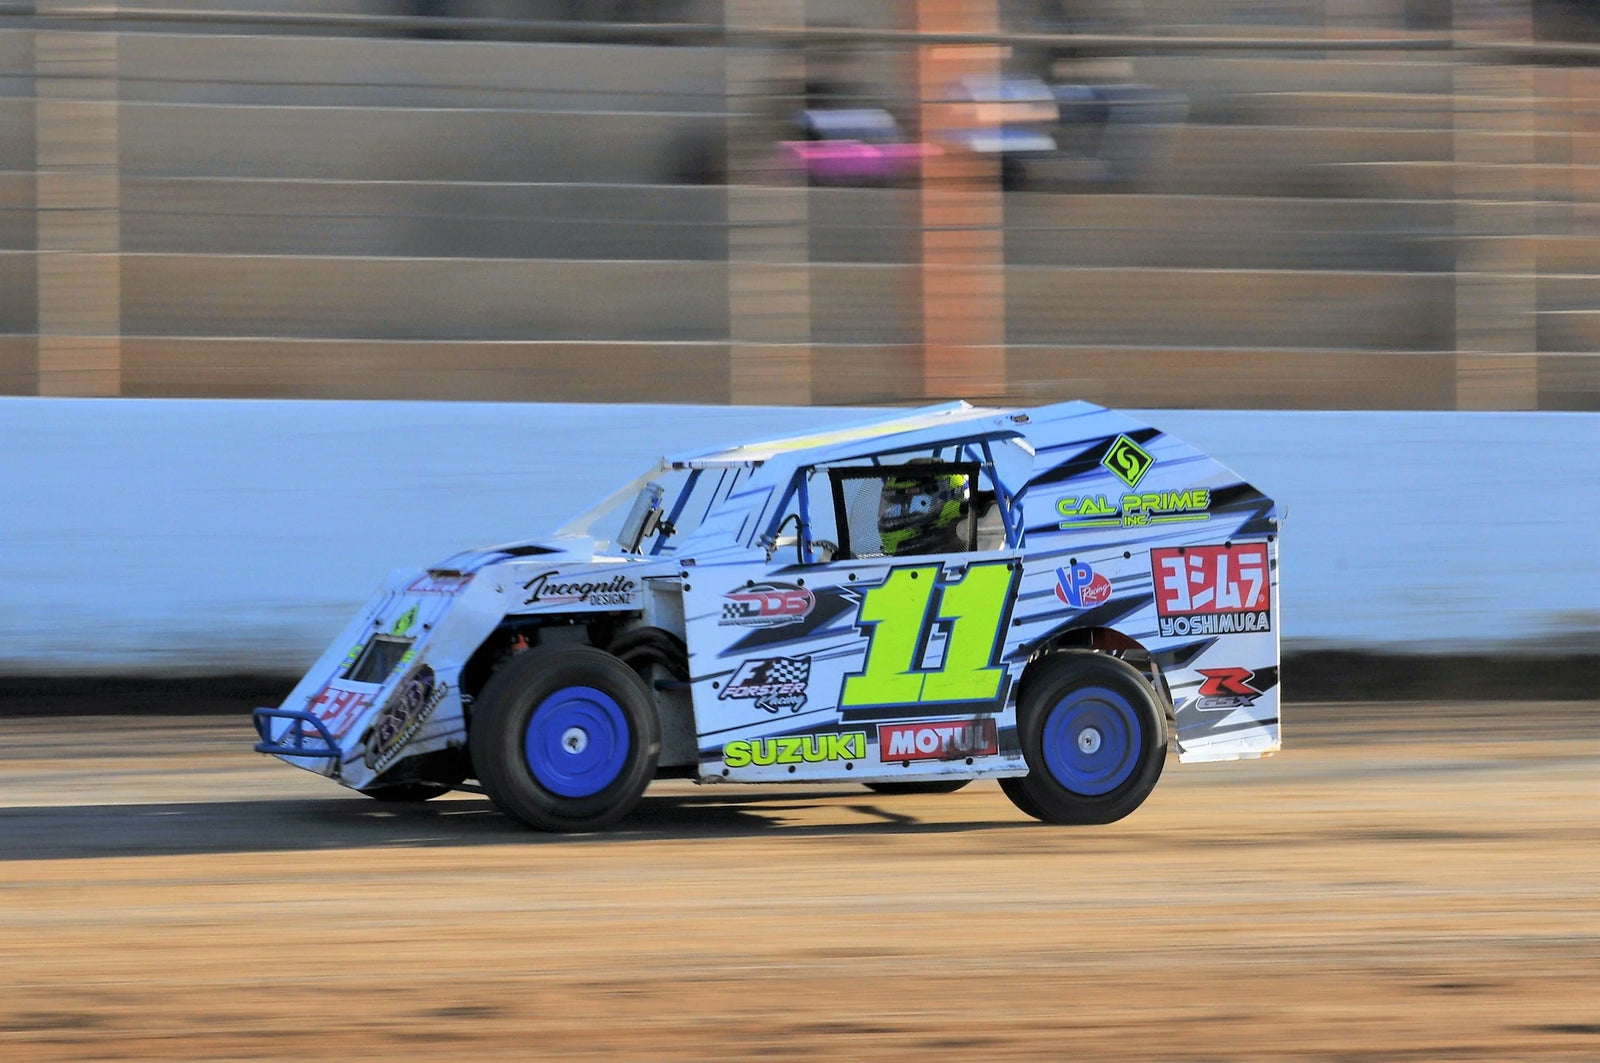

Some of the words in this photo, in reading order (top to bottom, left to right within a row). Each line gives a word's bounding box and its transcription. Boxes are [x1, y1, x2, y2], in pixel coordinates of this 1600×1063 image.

[1057, 496, 1117, 516] CAL
[1122, 489, 1210, 513] PRIME
[523, 570, 635, 606] Incognito
[1056, 562, 1093, 607] VP
[1081, 583, 1111, 603] Racing
[1161, 552, 1264, 612] ヨシムラ
[838, 561, 1018, 709] 11
[1160, 613, 1270, 637] YOSHIMURA
[719, 683, 806, 699] FORSTER
[1195, 667, 1257, 697] R
[722, 732, 867, 768] SUZUKI
[888, 725, 989, 756] MOTUL
